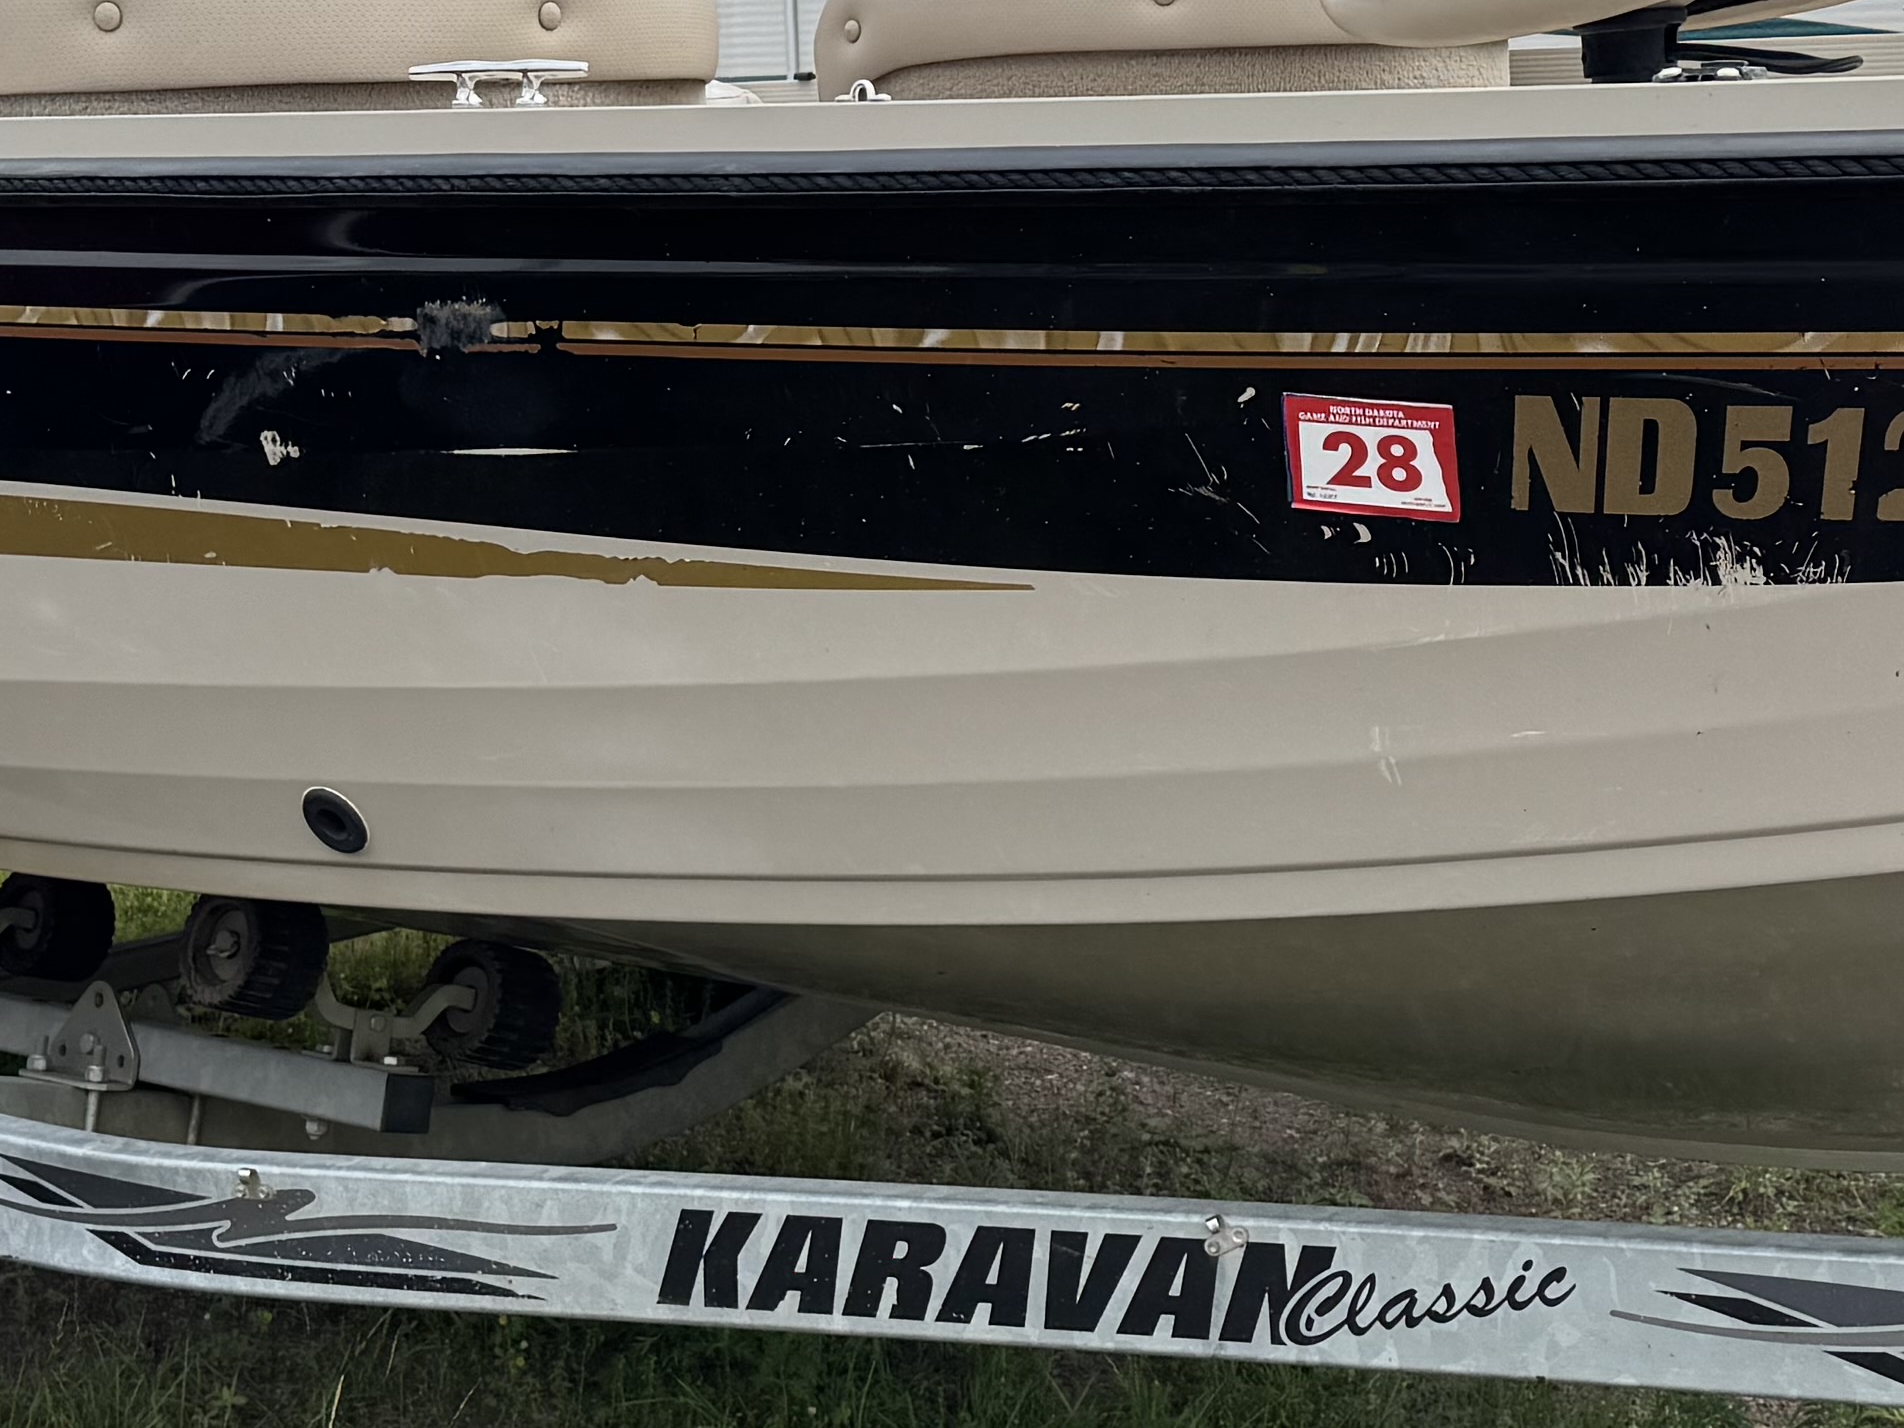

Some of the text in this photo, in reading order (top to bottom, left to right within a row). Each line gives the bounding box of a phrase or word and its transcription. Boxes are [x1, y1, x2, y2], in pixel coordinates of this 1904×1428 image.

[1298, 411, 1326, 422] GAME
[1328, 413, 1349, 424] AND
[1375, 417, 1440, 430] DEPARTMENT
[1329, 405, 1405, 419] NORTH DAKOTA
[1322, 430, 1423, 493] 28
[657, 1208, 1578, 1347] KARAVAN Classic
